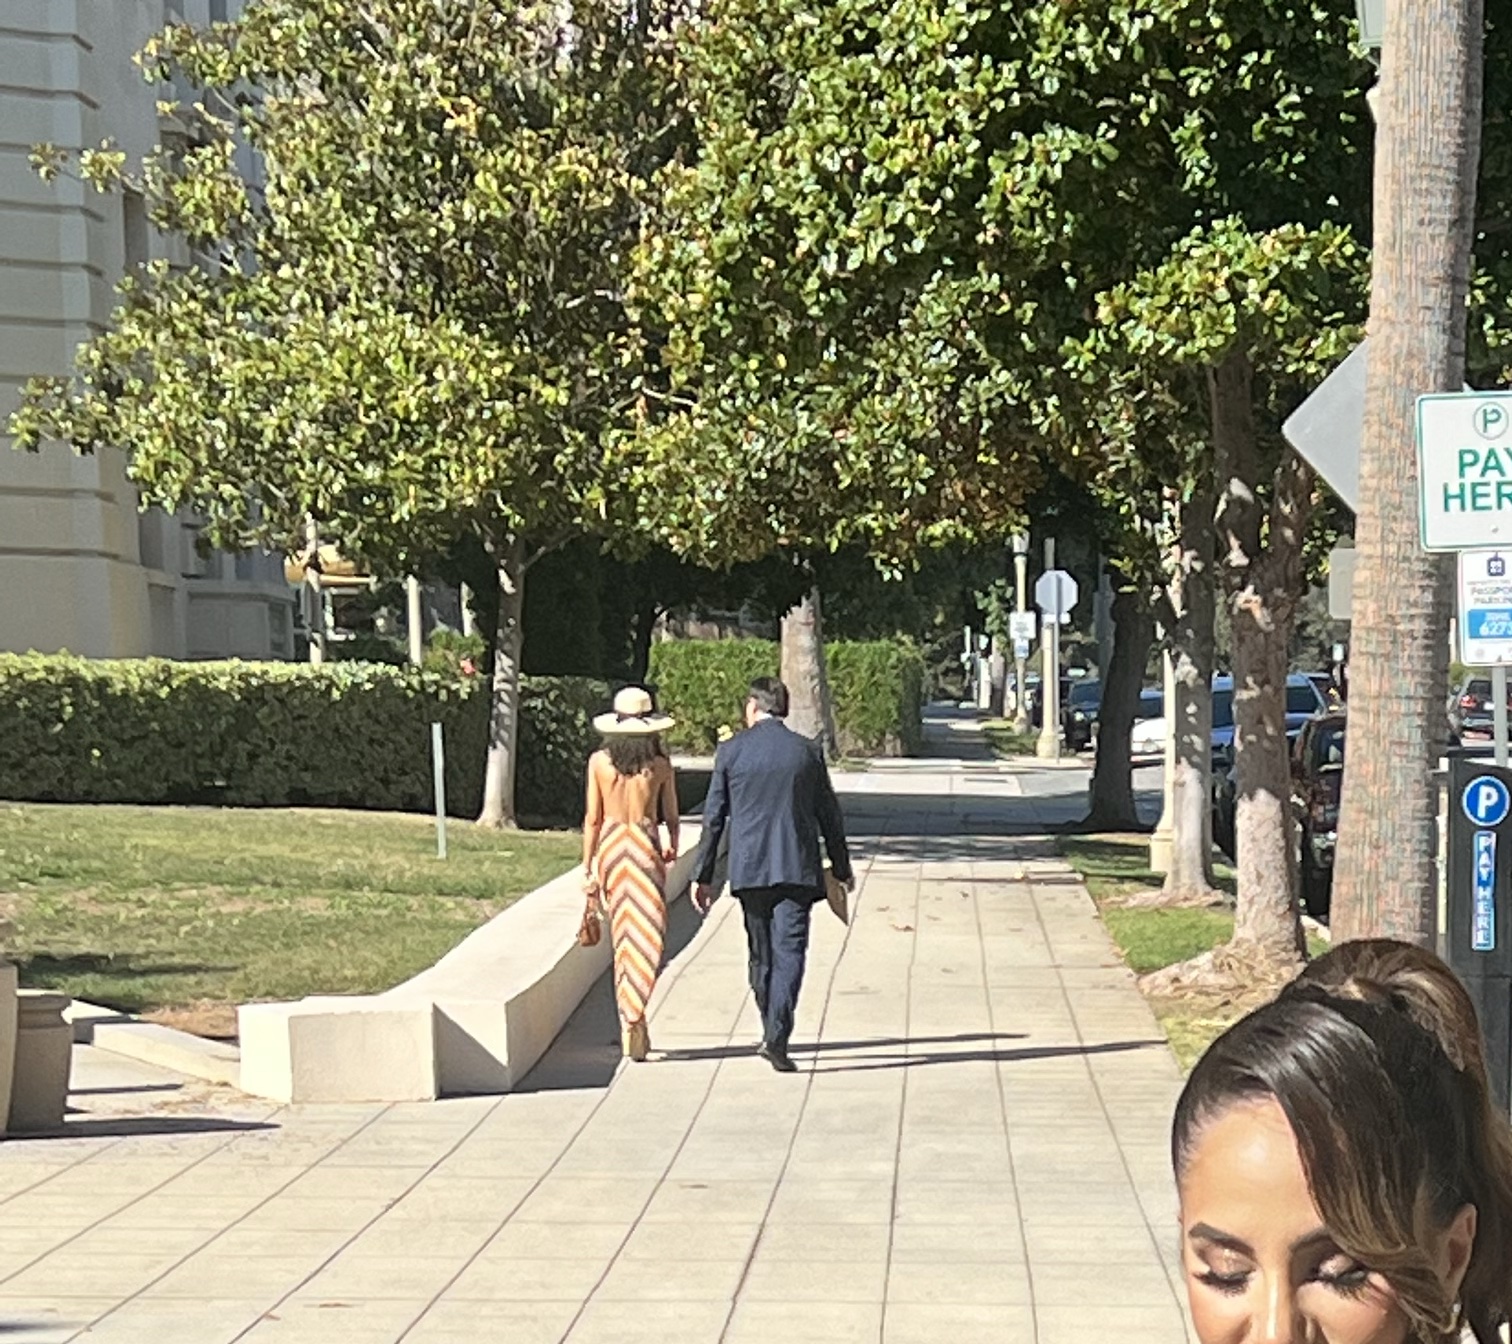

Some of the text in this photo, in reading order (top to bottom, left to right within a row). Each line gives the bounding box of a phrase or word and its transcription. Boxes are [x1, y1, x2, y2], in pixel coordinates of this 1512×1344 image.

[1476, 785, 1499, 819] P
[1476, 835, 1493, 943] PAY HERE
